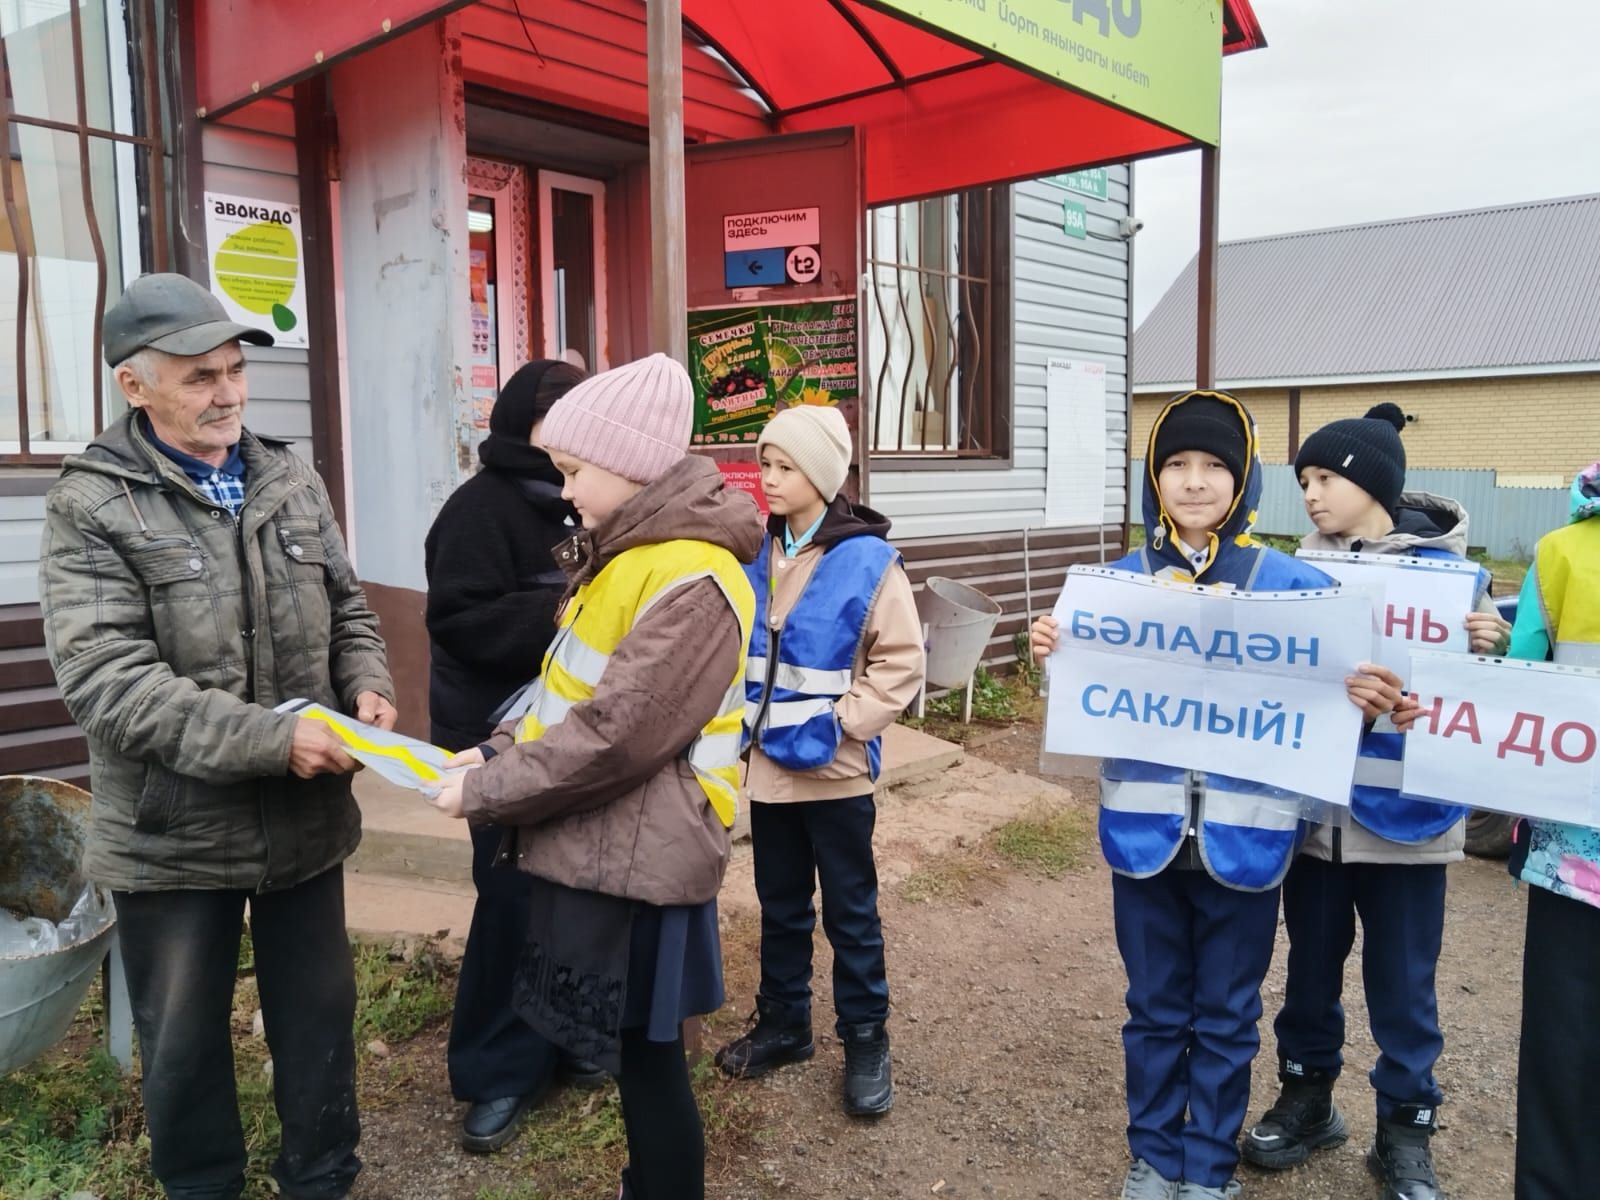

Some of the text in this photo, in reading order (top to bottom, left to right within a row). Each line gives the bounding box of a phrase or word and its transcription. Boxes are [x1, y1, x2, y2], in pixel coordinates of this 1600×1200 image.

[1111, 61, 1150, 88] кибет
[215, 201, 292, 225] авокадо
[727, 213, 807, 228] ПОДКЛЮЧИМ
[728, 227, 768, 239] ЗДЕСЬ
[794, 254, 815, 274] t2
[700, 323, 754, 345] СЕМЕЧКИ
[1376, 604, 1449, 643] НЬ
[1071, 610, 1319, 666] БӘЛАДӘН
[1082, 684, 1305, 750] САКЛЫЙ!
